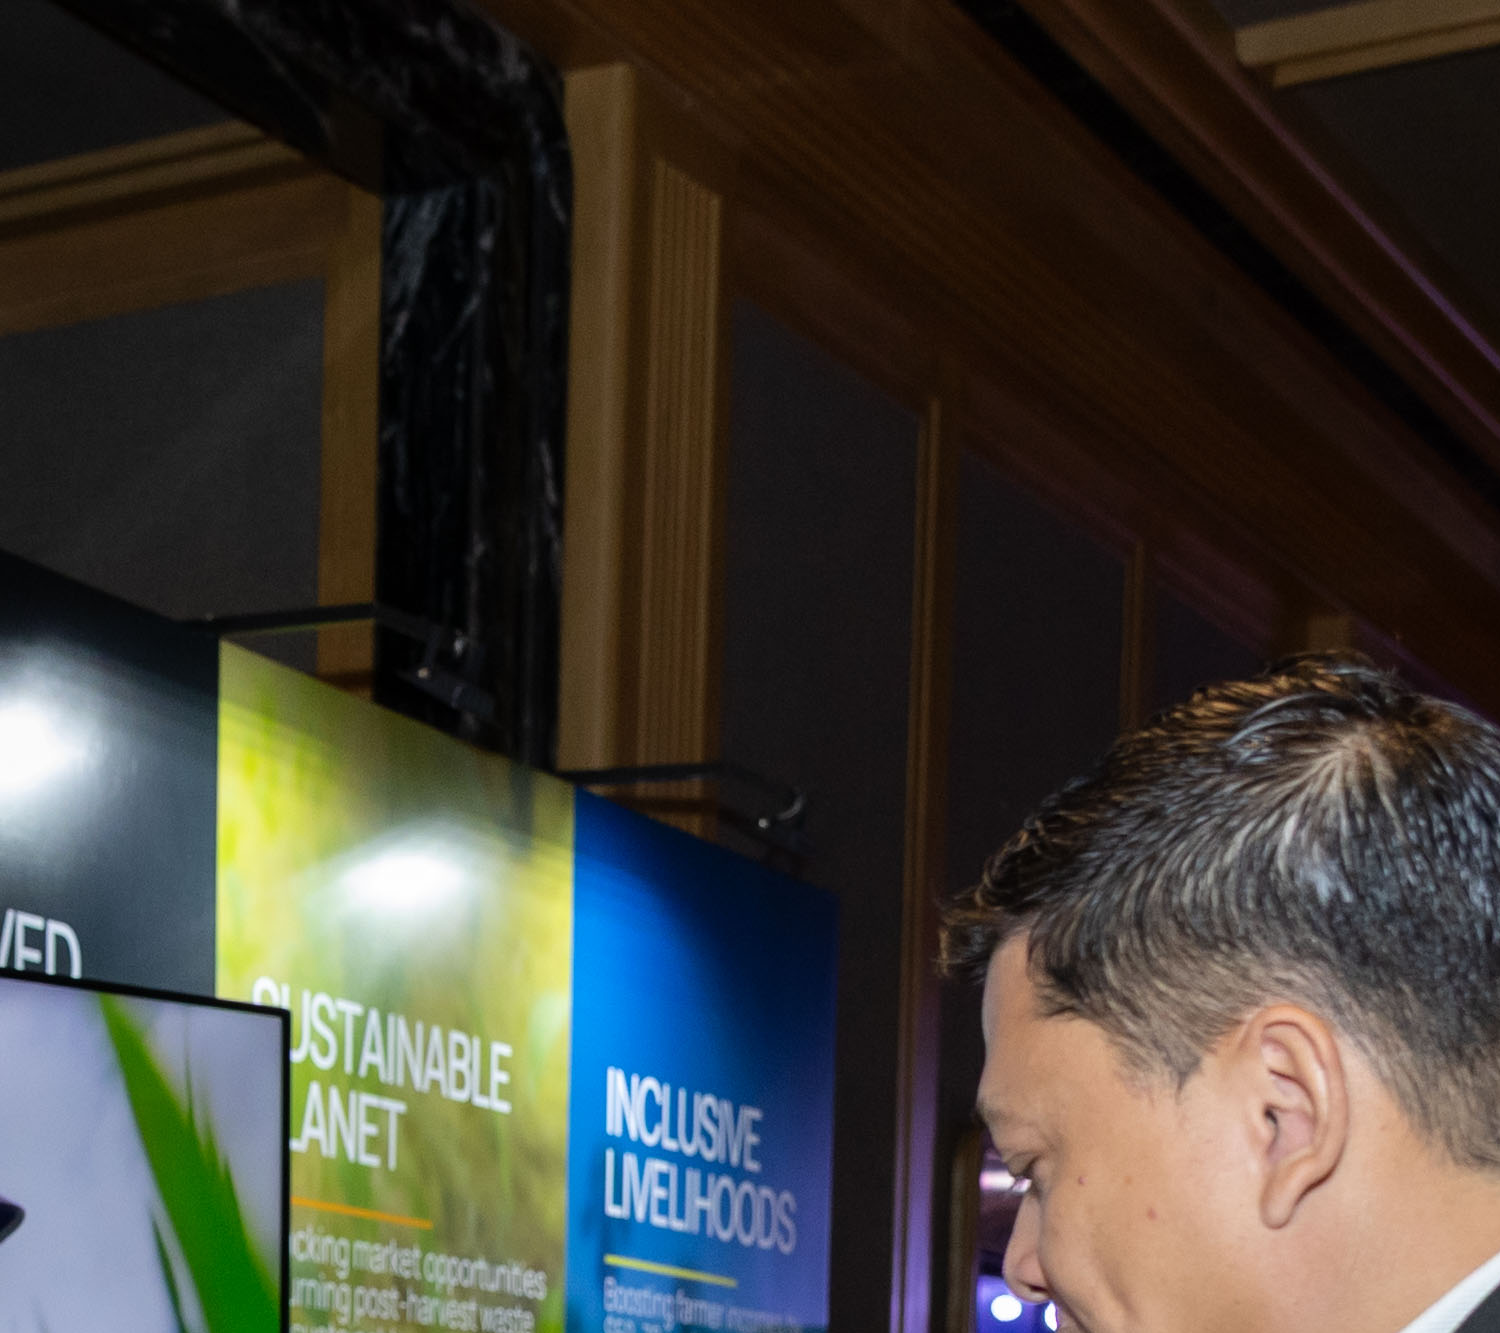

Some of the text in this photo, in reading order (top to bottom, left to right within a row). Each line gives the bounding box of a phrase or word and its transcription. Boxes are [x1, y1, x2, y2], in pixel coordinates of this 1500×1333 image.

[606, 1065, 762, 1173] INCLUSIVE
[604, 1147, 797, 1255] LIVELIHOODS
[353, 1239, 420, 1281] market
[423, 1250, 547, 1301] opportunities
